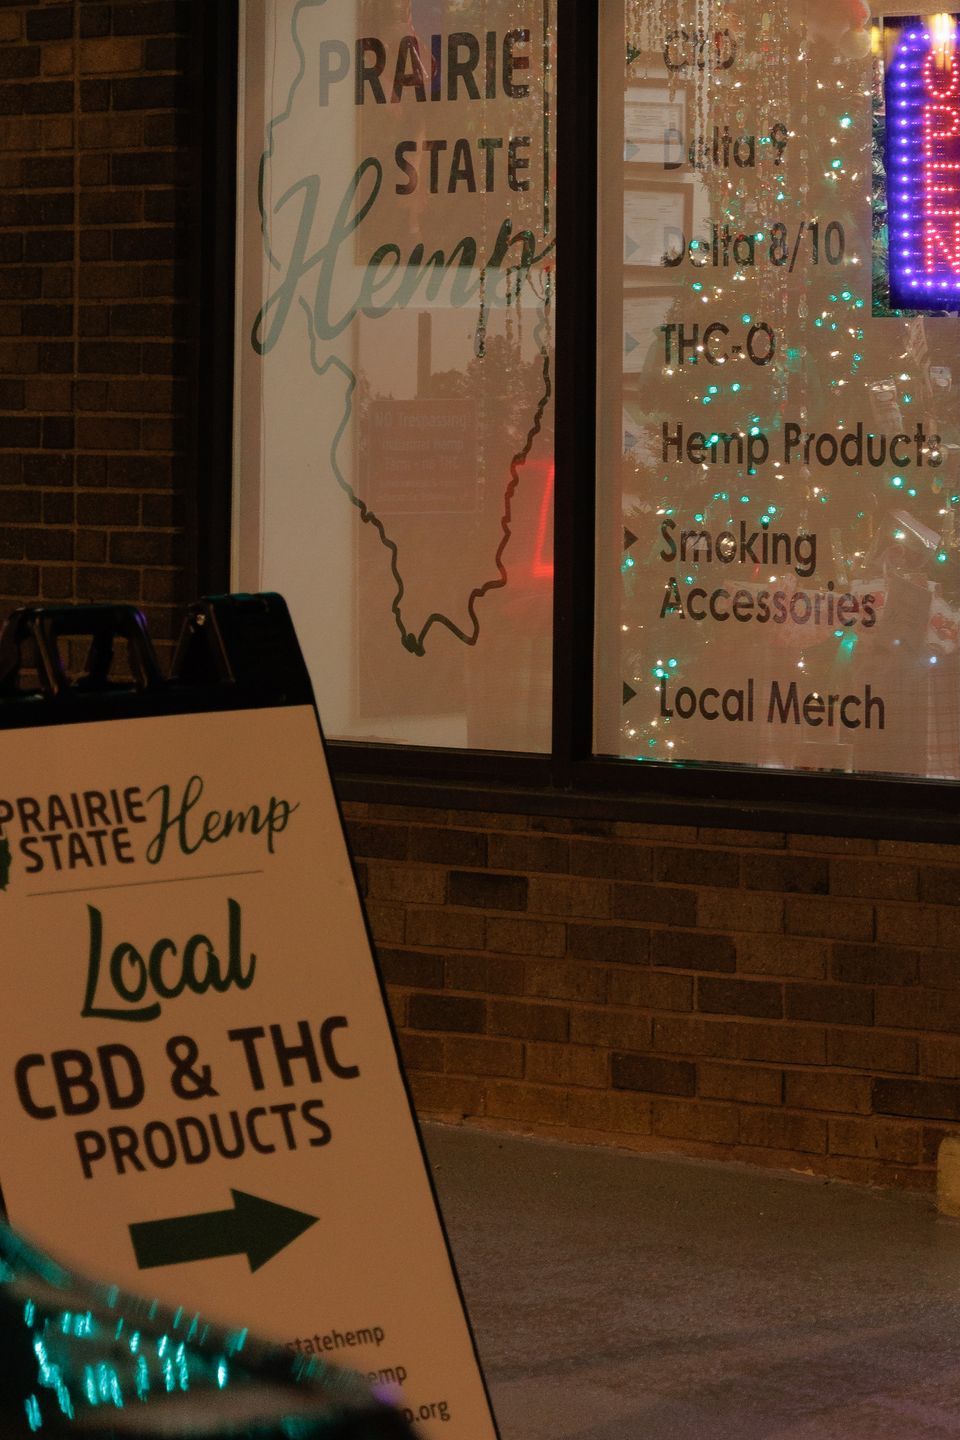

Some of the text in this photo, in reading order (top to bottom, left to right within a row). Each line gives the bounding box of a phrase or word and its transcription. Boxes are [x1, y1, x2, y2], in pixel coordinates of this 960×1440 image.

[318, 28, 532, 108] PRAIRIE
[395, 135, 532, 196] STATE
[664, 126, 756, 172] Delta
[251, 156, 557, 359] Hemp
[663, 220, 846, 275] Delta 8/10
[661, 321, 777, 367] THC-O
[661, 421, 944, 476] Hemp Products
[660, 519, 817, 578] Smoking
[660, 581, 878, 628] Accessories
[660, 677, 886, 731] Local Merch
[0, 775, 301, 865] PRAIRIE Hemp
[20, 828, 136, 875] STATE
[81, 897, 257, 1023] Local
[14, 1016, 362, 1121] CBD & THC
[74, 1099, 333, 1180] PRODUCTS
[286, 1326, 385, 1355] statehemp
